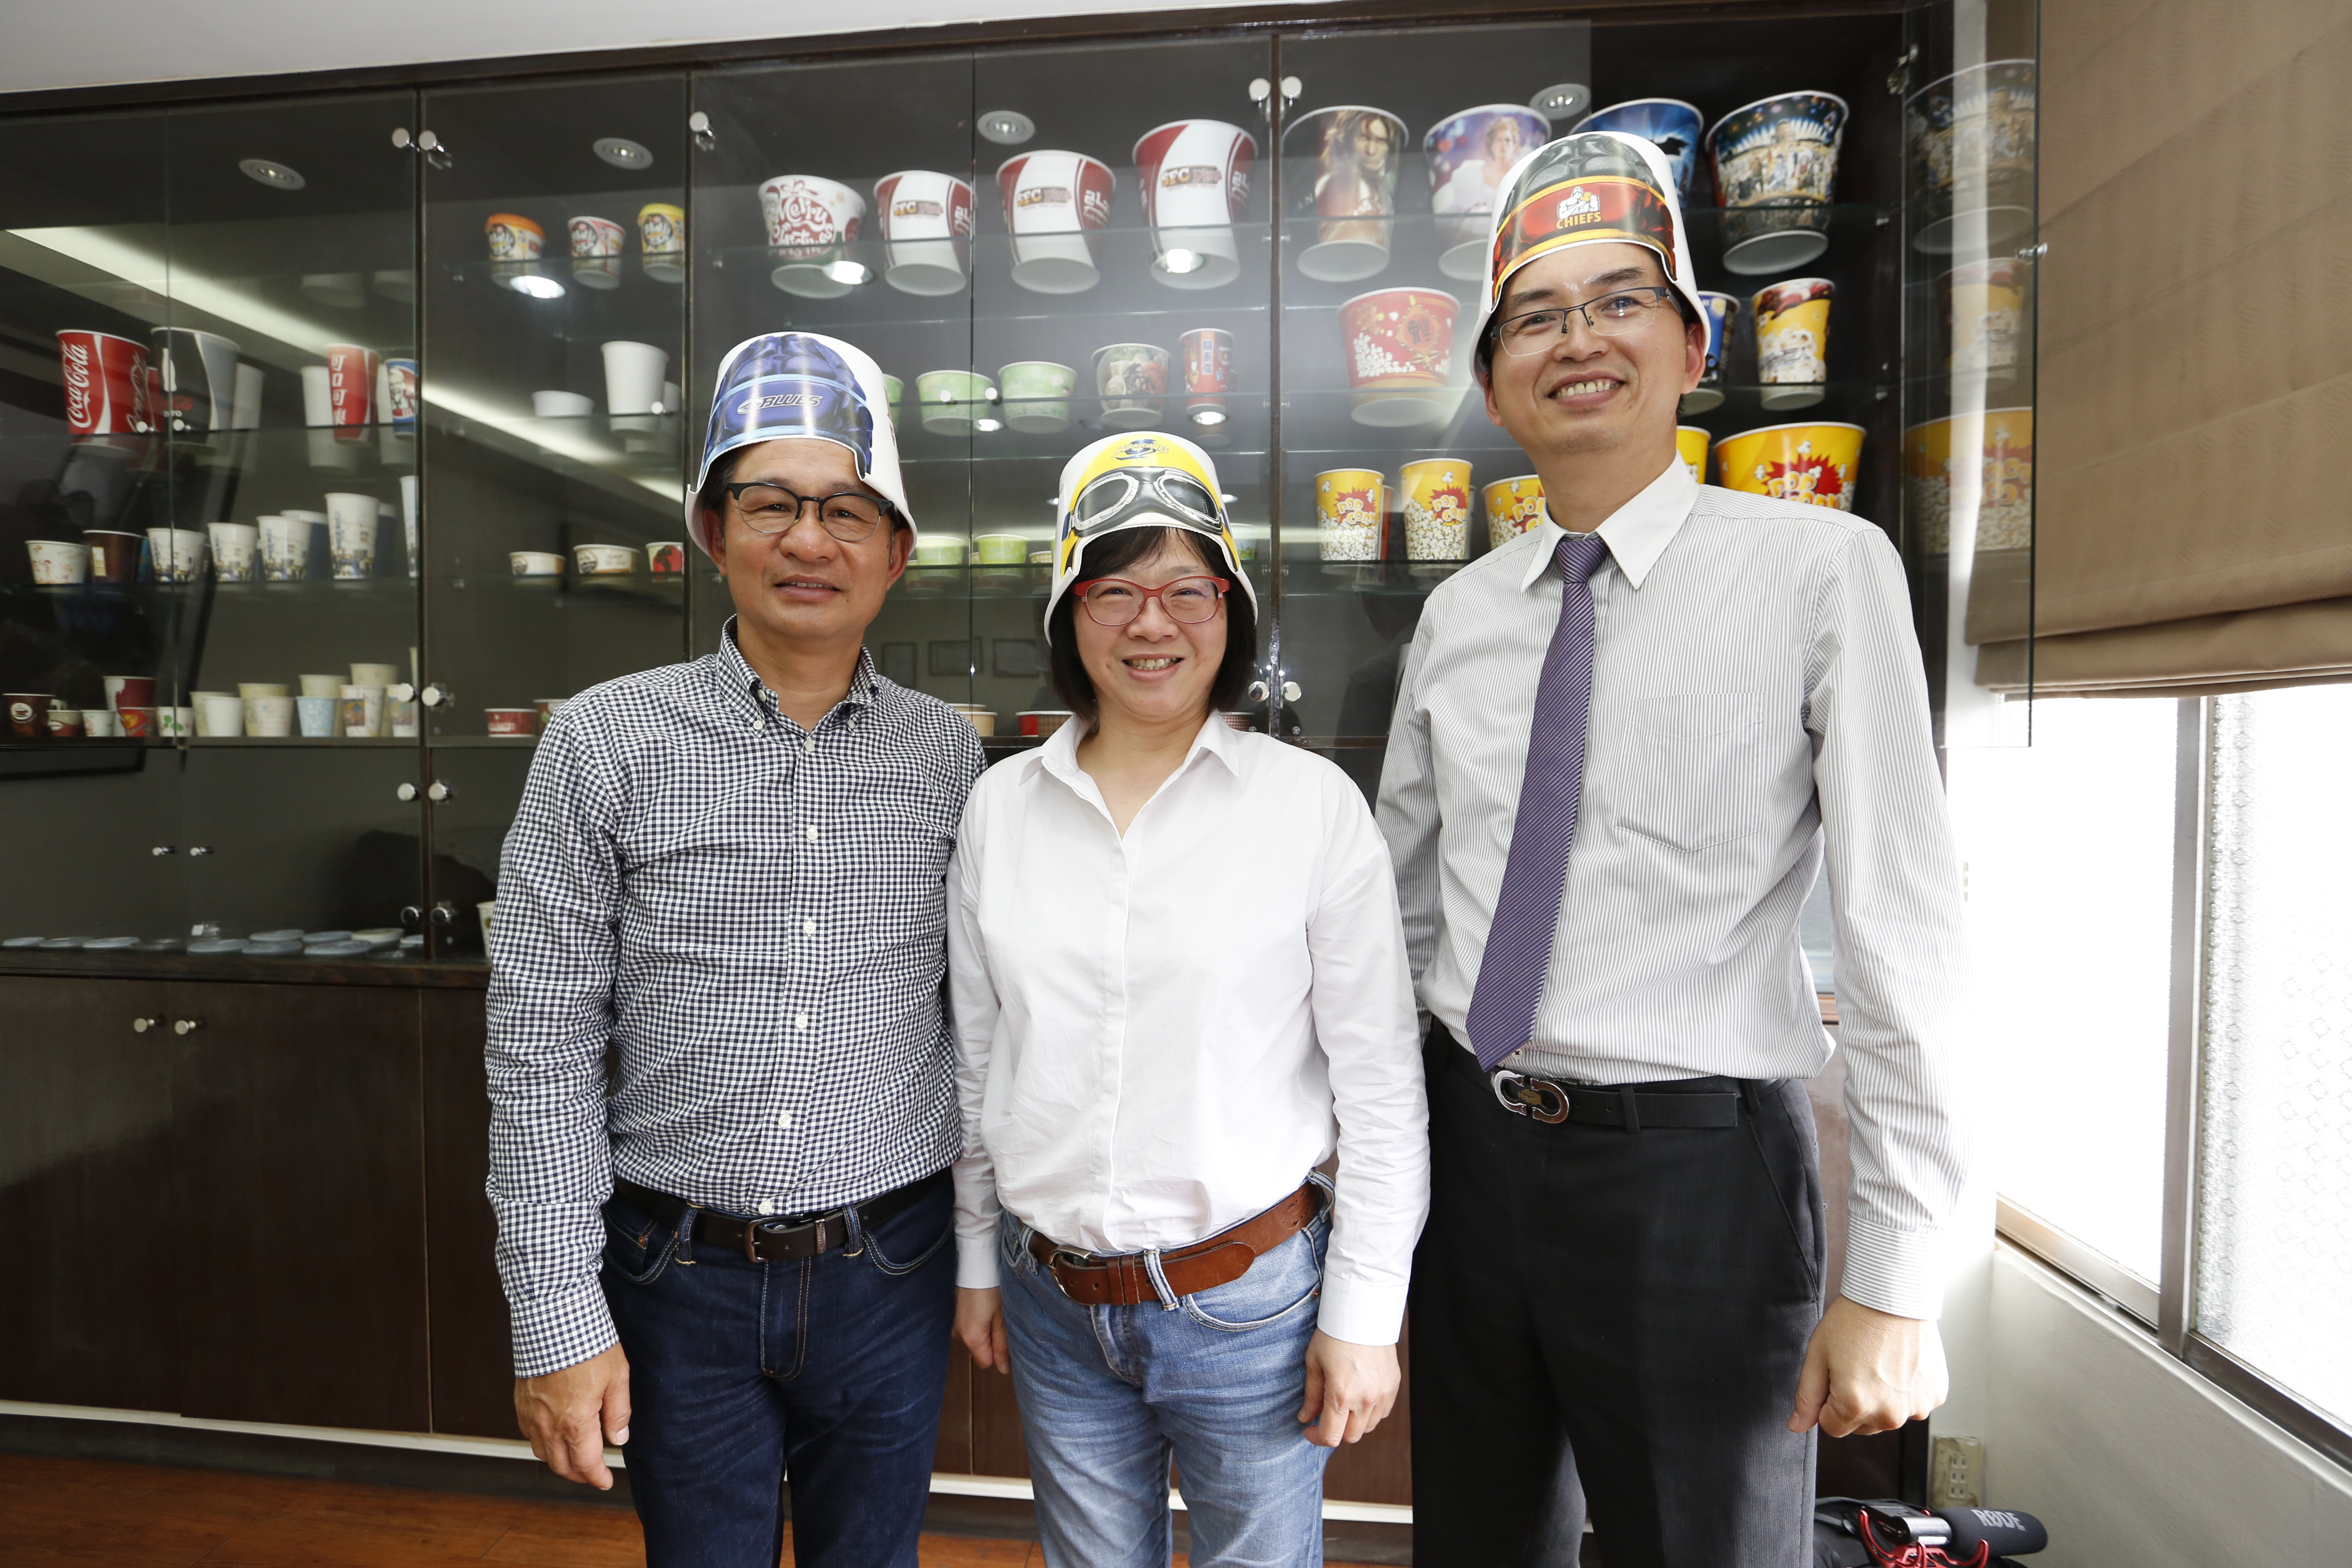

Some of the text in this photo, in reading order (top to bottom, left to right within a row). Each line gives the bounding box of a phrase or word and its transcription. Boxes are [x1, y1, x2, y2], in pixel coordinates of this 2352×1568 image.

[1556, 212, 1602, 229] CHIEFS
[761, 394, 824, 408] BLUES
[1110, 443, 1170, 459] HURRICANES
[1767, 470, 1817, 498] POP
[1336, 497, 1364, 515] POP
[1432, 494, 1459, 512] POP
[1346, 509, 1376, 526] CORN
[1970, 1509, 2026, 1532] RØDE
